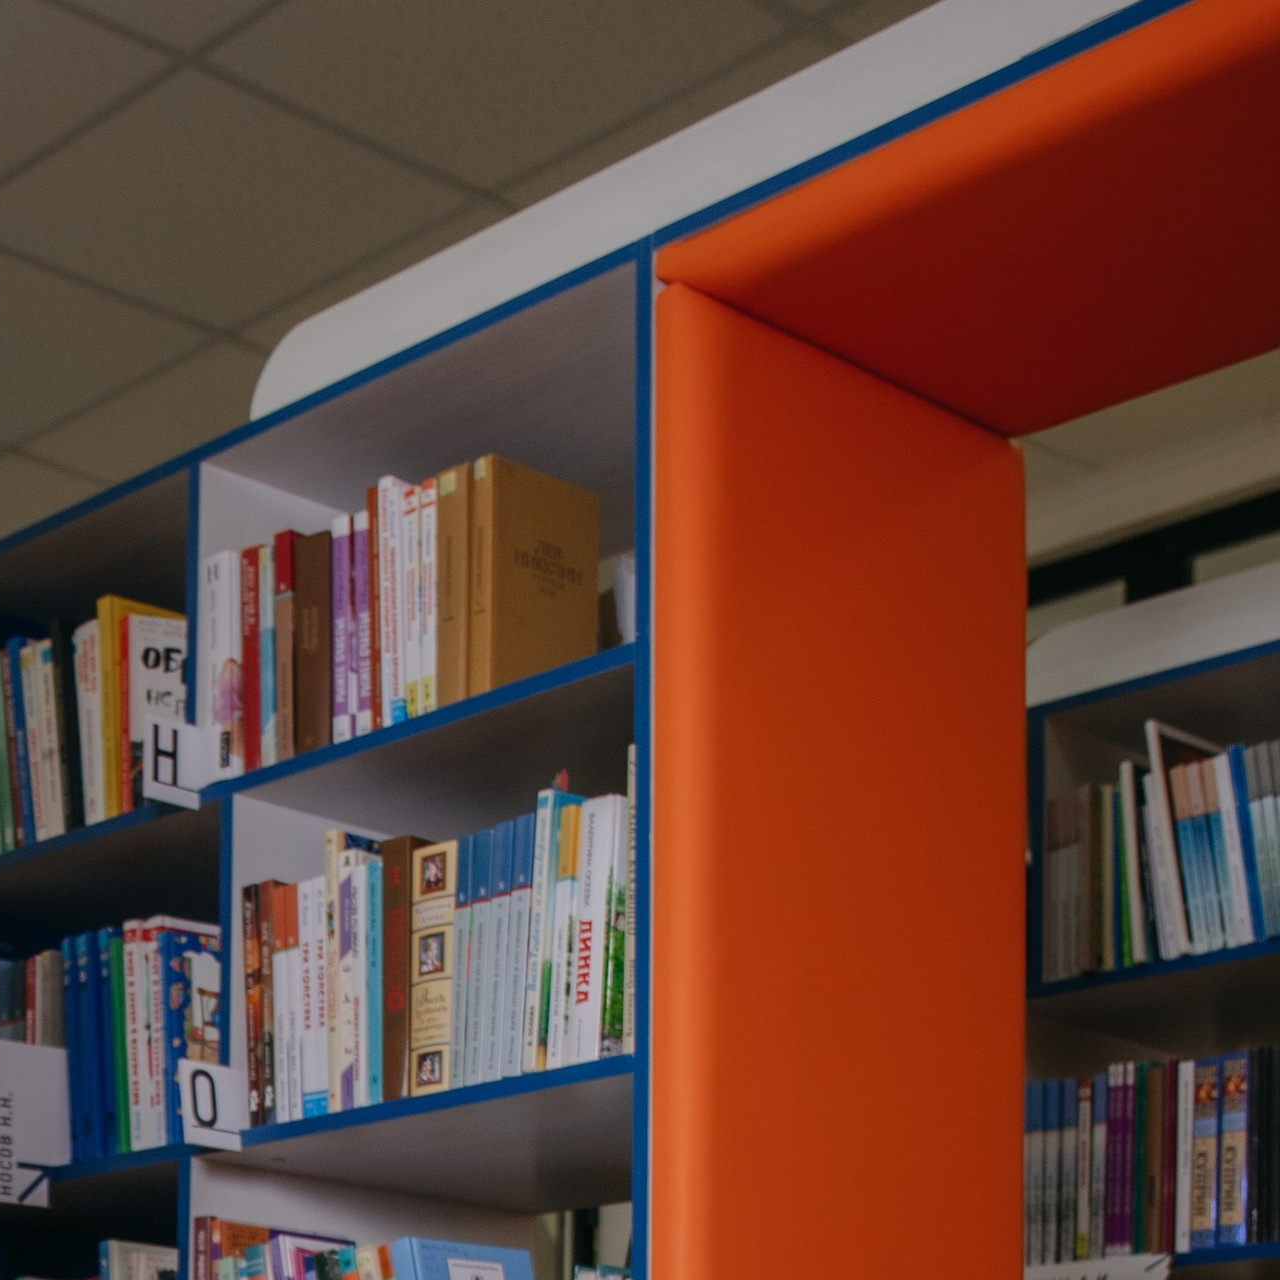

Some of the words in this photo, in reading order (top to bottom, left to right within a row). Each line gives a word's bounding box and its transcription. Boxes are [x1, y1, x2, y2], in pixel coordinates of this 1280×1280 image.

[152, 724, 178, 787] Н
[575, 919, 593, 1006] ДИНКА
[190, 1068, 217, 1128] О
